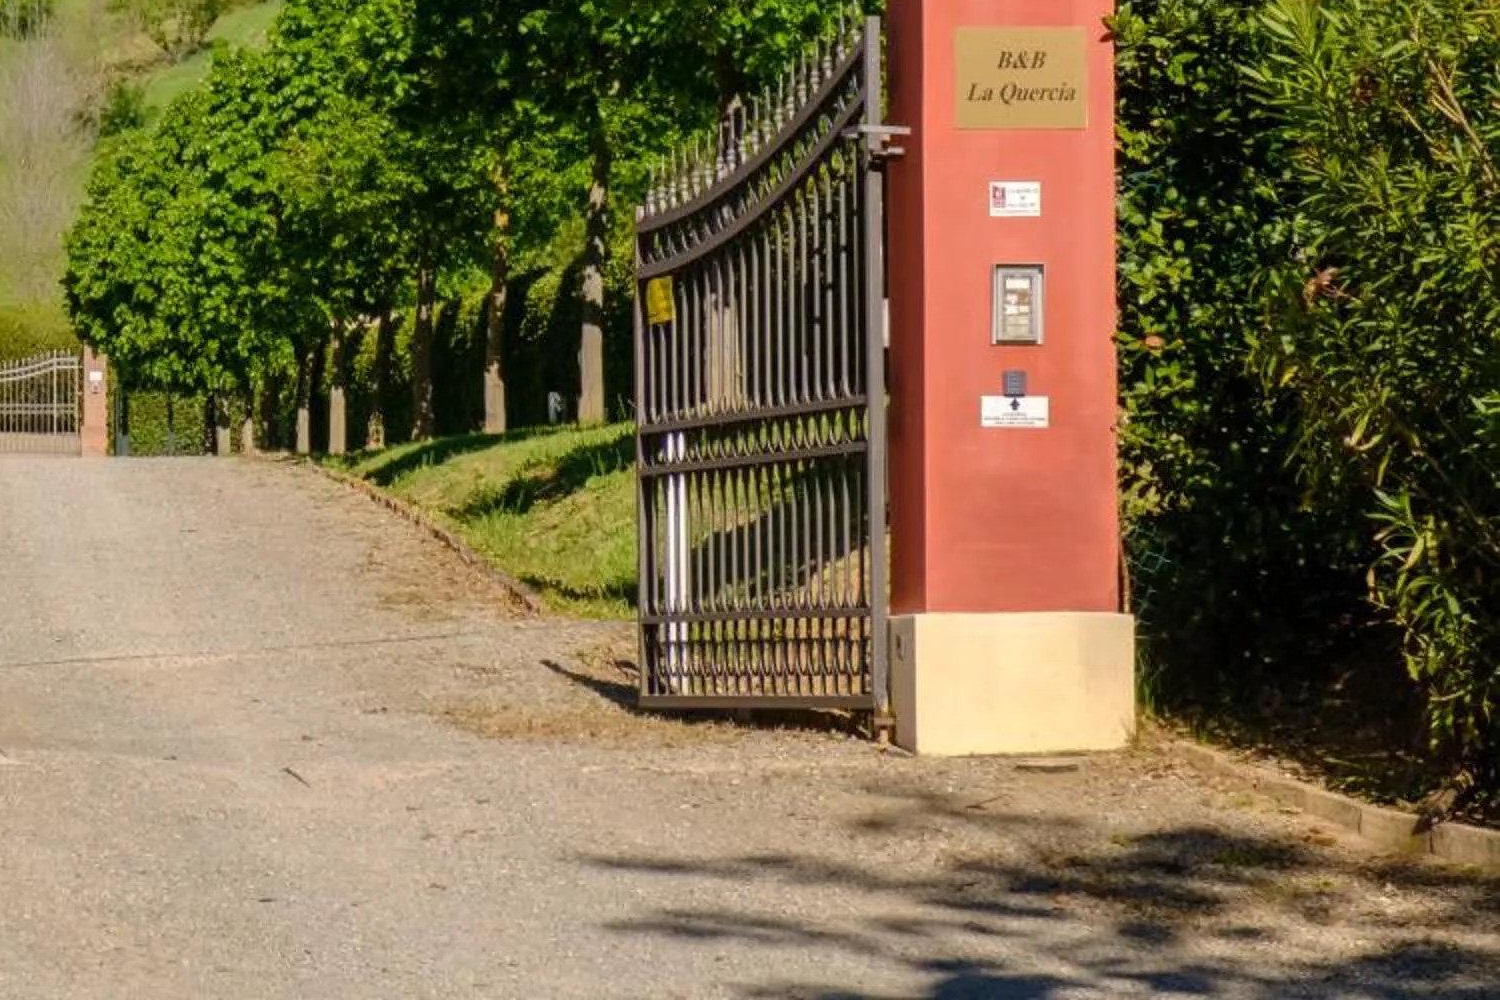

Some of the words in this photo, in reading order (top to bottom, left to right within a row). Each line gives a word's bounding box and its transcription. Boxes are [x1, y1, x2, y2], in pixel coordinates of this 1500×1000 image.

[996, 50, 1047, 69] B&B
[967, 83, 993, 102] La
[999, 81, 1077, 105] Quercia
